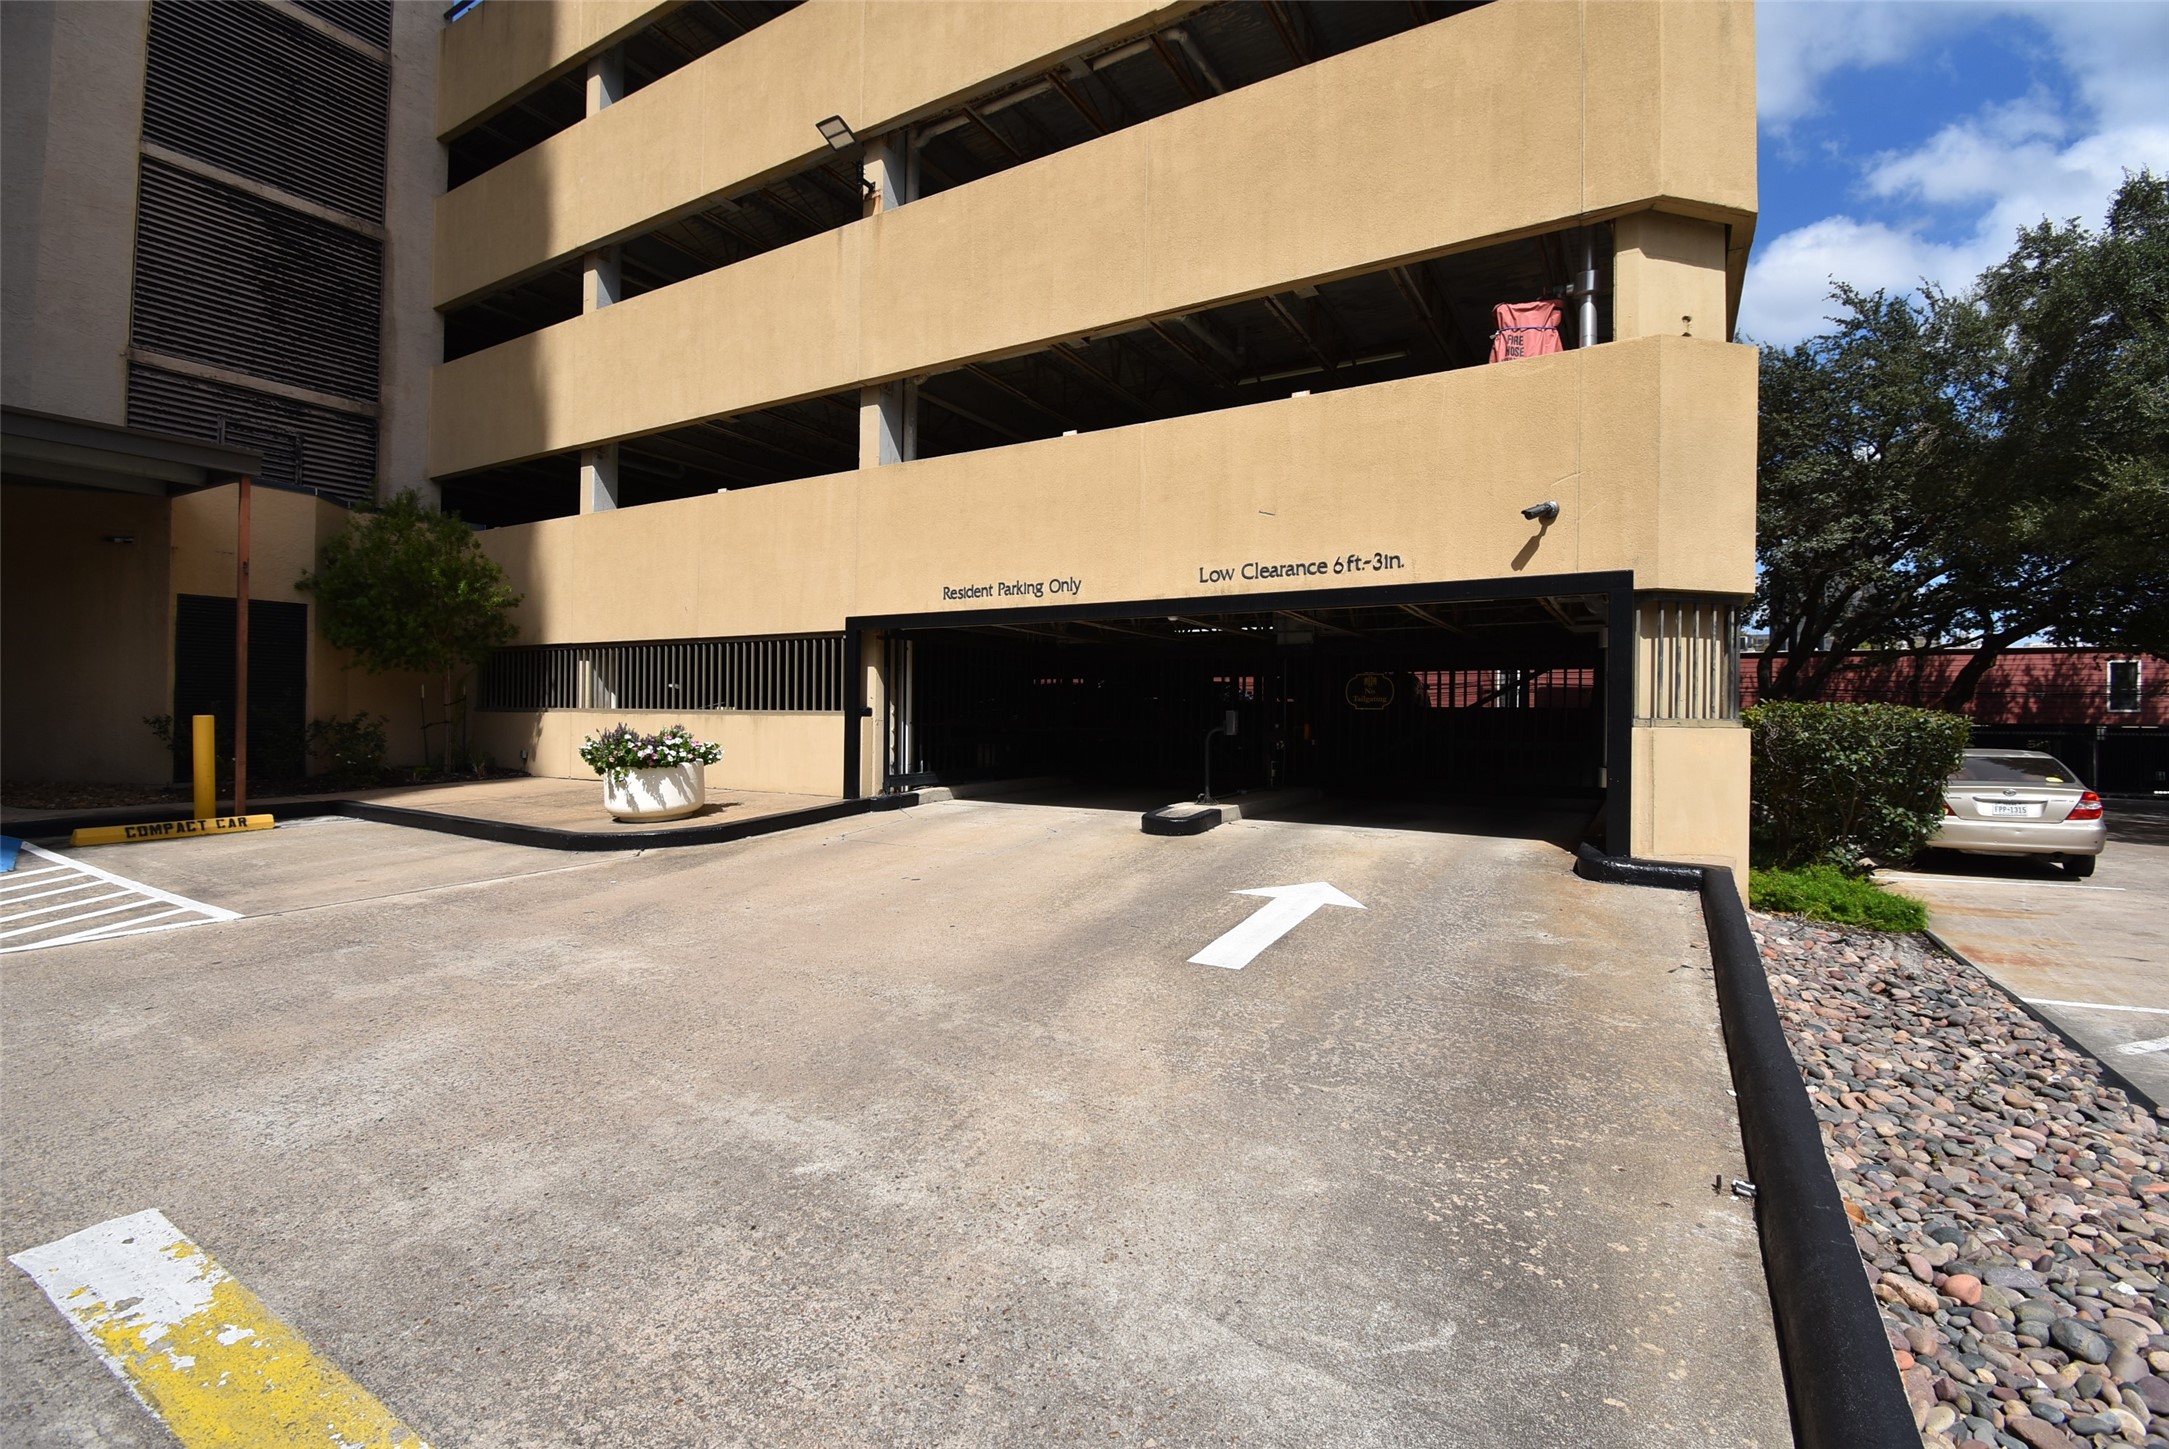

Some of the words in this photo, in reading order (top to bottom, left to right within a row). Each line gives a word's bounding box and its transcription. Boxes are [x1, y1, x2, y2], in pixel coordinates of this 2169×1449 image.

[1505, 346, 1524, 357] HOSE
[1507, 335, 1523, 346] FIRE
[1199, 566, 1235, 583] Low
[1241, 561, 1328, 580] Clearance
[943, 583, 993, 600] Resident
[998, 580, 1044, 598] Parking
[1049, 576, 1082, 595] Only
[124, 820, 206, 839] COMPACT
[216, 816, 248, 829] CAR
